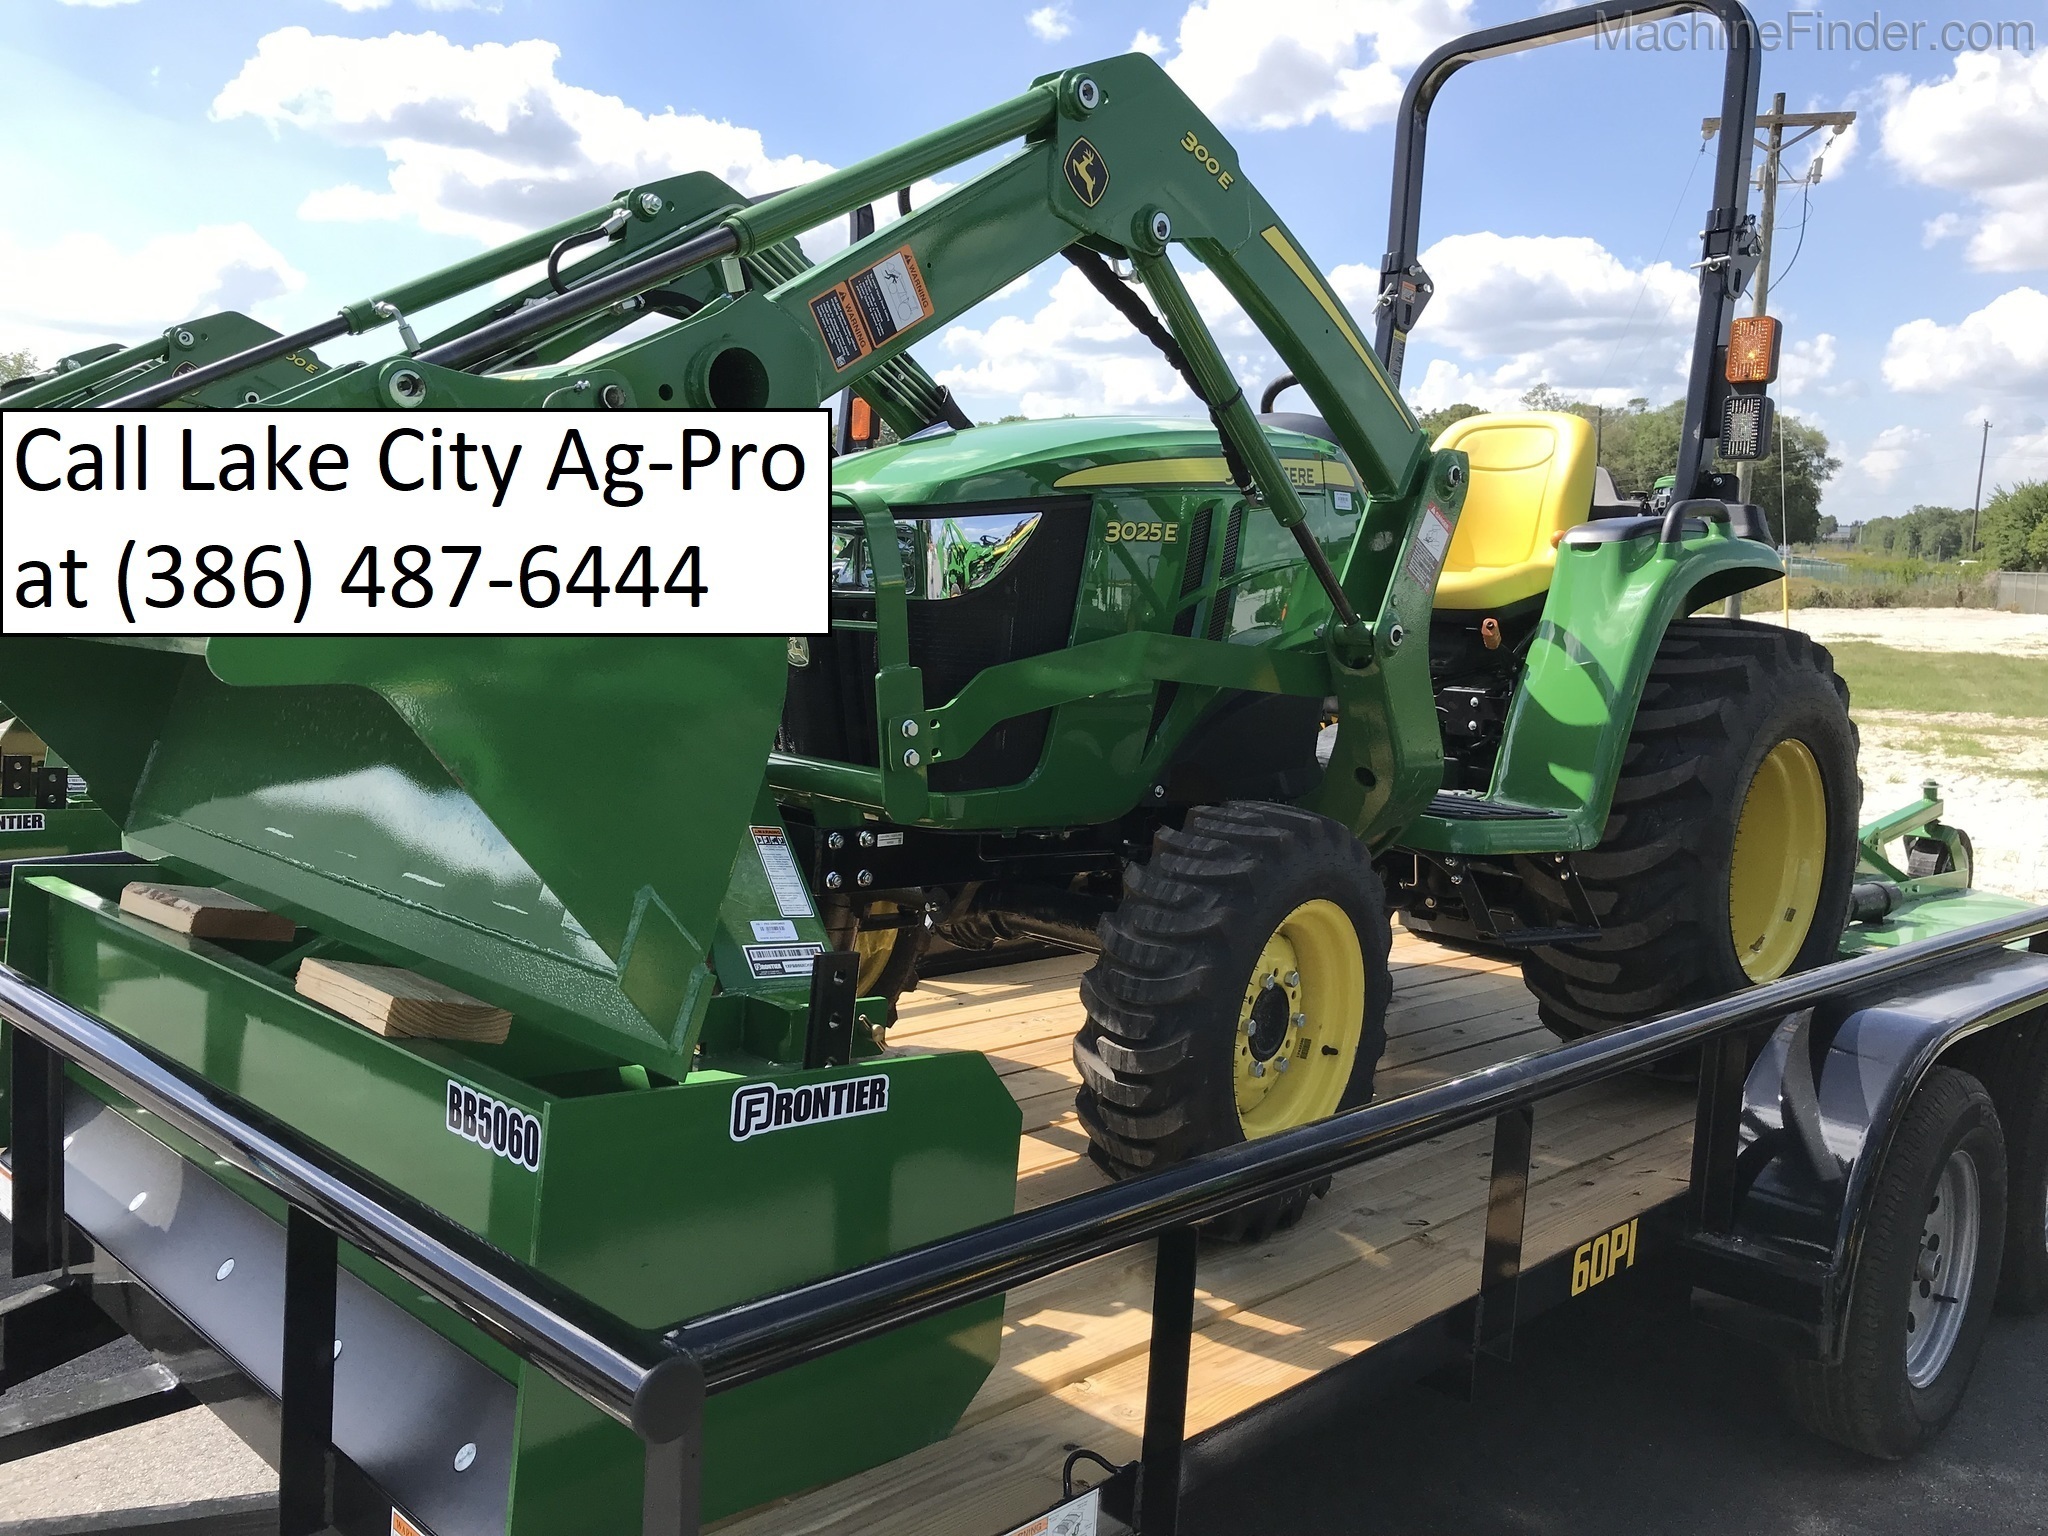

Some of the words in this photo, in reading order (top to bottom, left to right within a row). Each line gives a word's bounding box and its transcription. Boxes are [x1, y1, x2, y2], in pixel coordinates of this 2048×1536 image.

[909, 265, 929, 309] WARNING
[845, 303, 866, 348] WARNING
[1105, 521, 1178, 543] 3025E
[448, 1083, 539, 1168] BB5060
[734, 1076, 887, 1138] FRONTIER
[1571, 1217, 1639, 1297] 60PI
